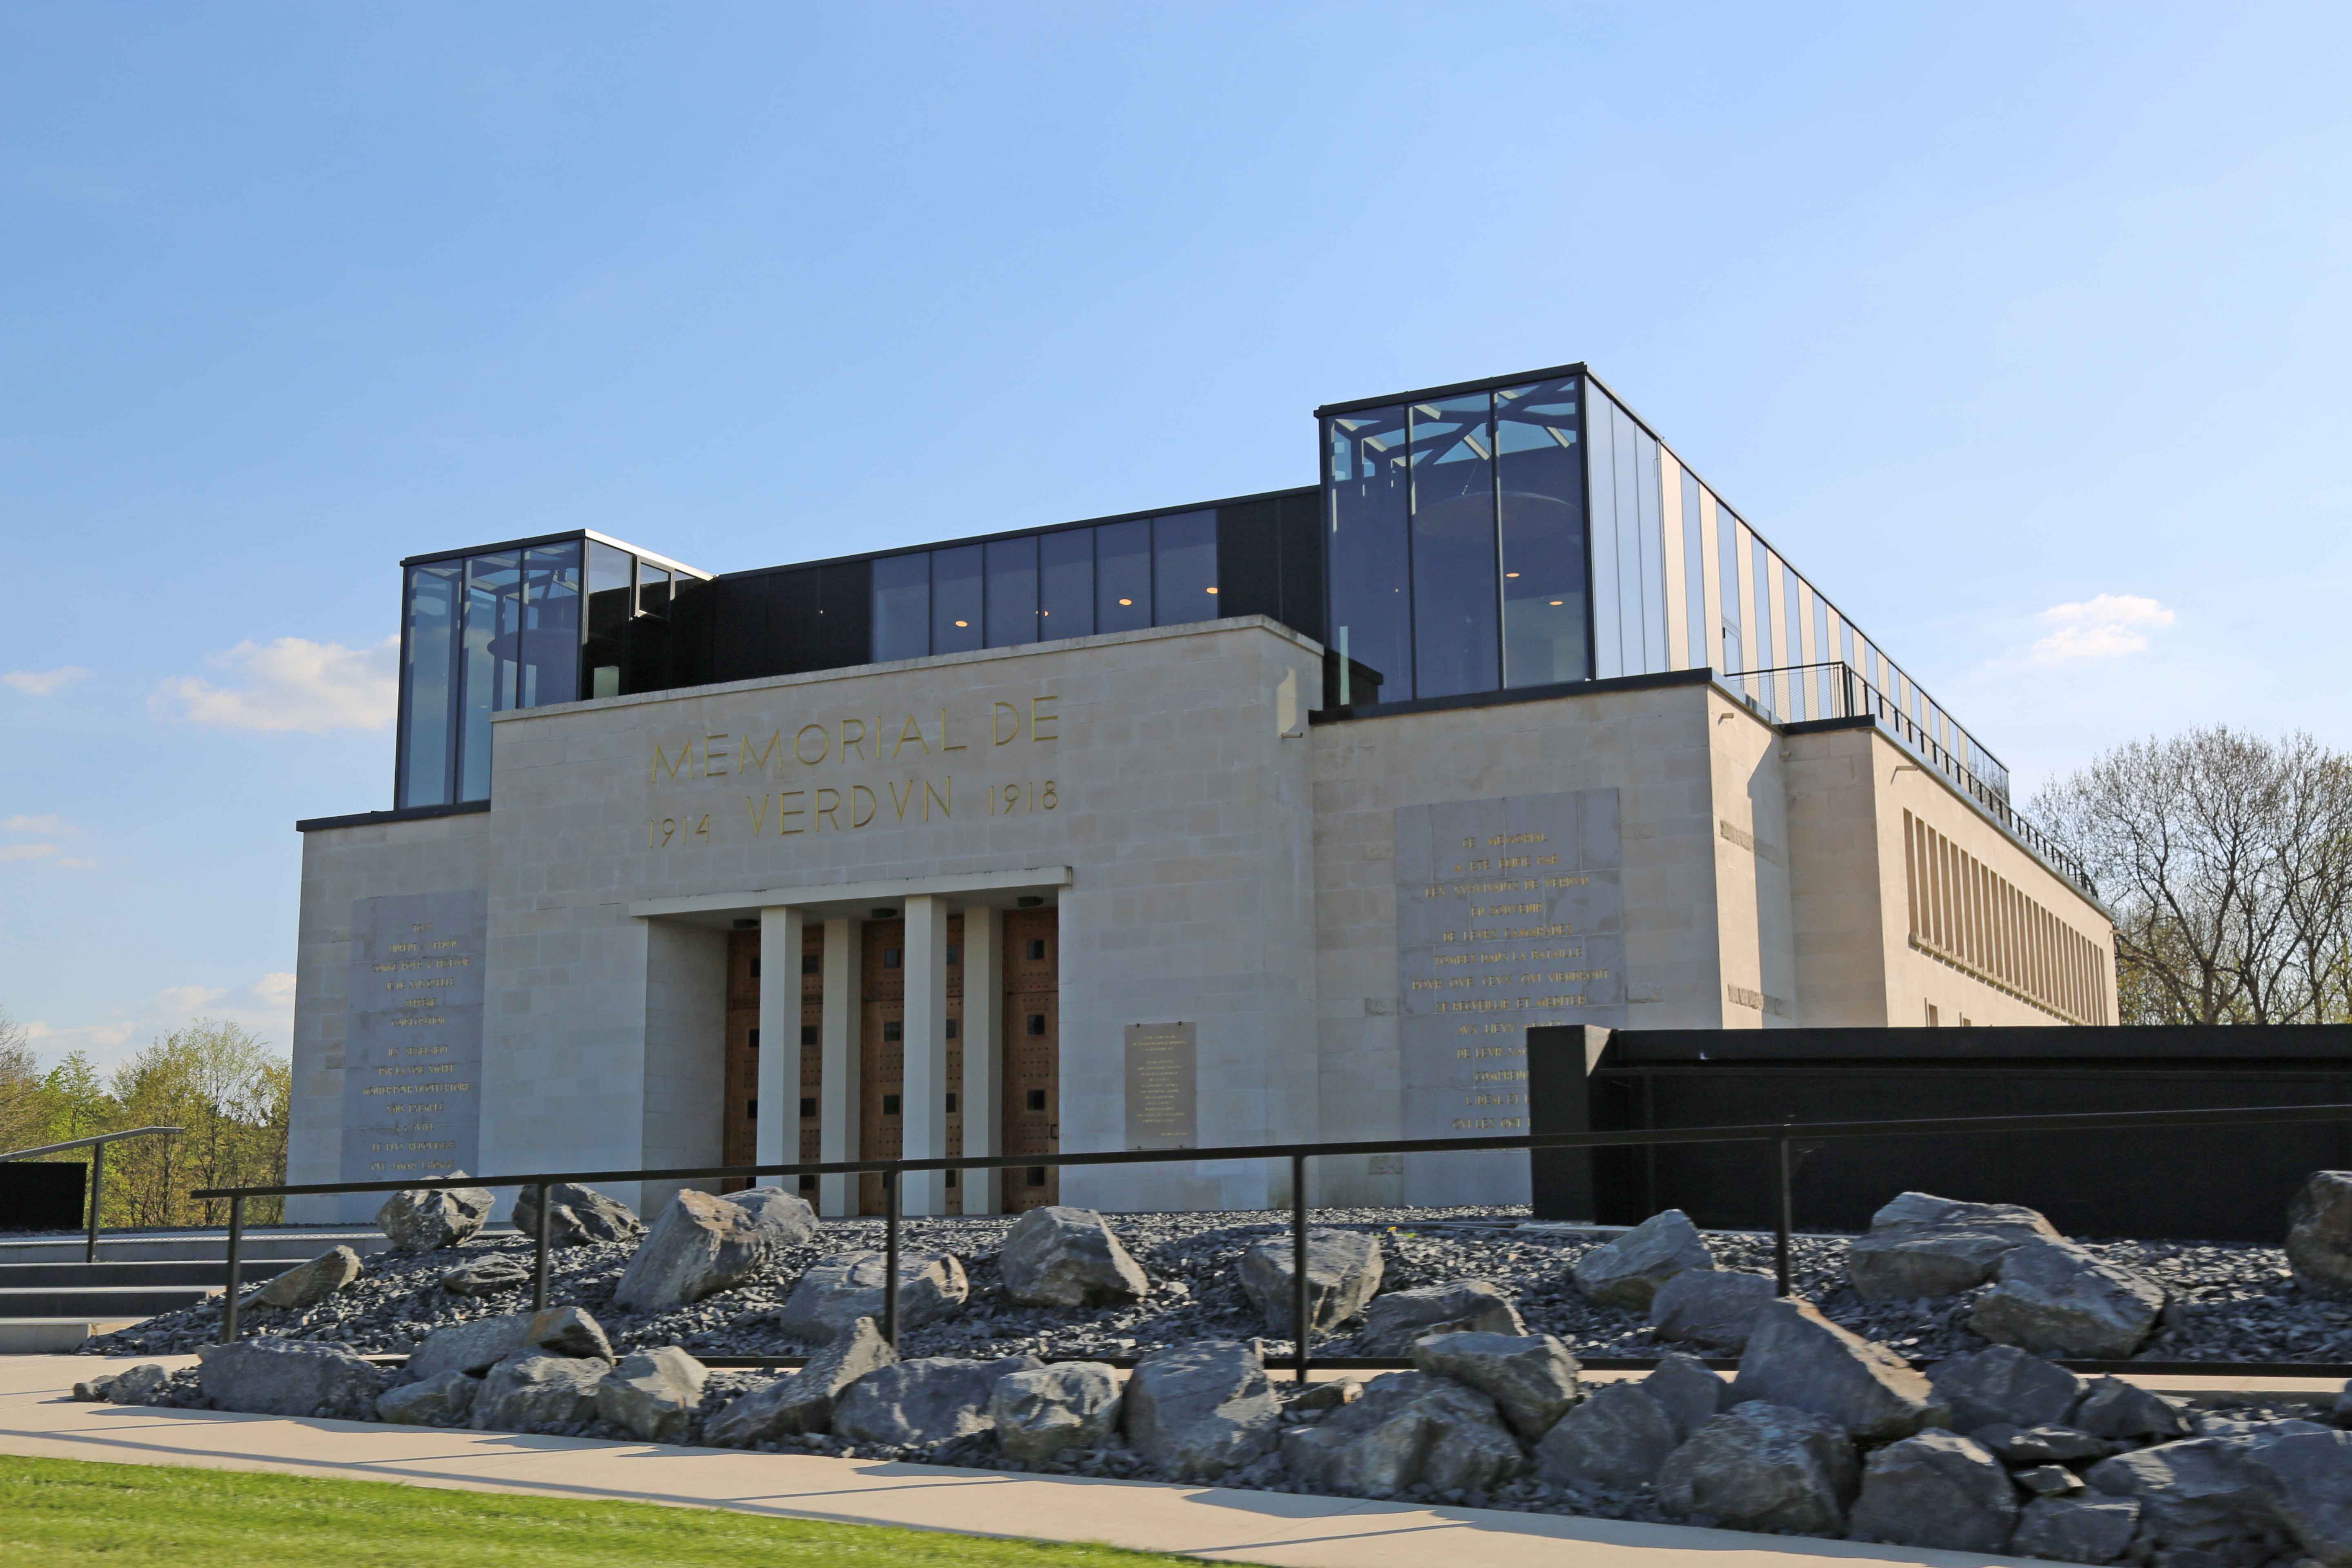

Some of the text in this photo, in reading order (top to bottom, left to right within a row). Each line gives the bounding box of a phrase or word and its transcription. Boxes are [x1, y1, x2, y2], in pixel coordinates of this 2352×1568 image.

[651, 695, 1060, 784] MEMORIAL DE
[649, 775, 1059, 849] 1914 VERDVN 1918
[1462, 833, 1548, 848] CE MEMORIAL
[1425, 886, 1446, 898] LES
[1524, 879, 1539, 891] DE
[1471, 906, 1486, 918] EN
[1443, 931, 1457, 942] DE
[1434, 947, 1583, 965] TOMBES DANS LA BATAILLE
[1516, 997, 1532, 1009] ET
[1457, 1047, 1471, 1059] DE
[1507, 1093, 1519, 1104] ET
[1475, 1118, 1497, 1129] LES
